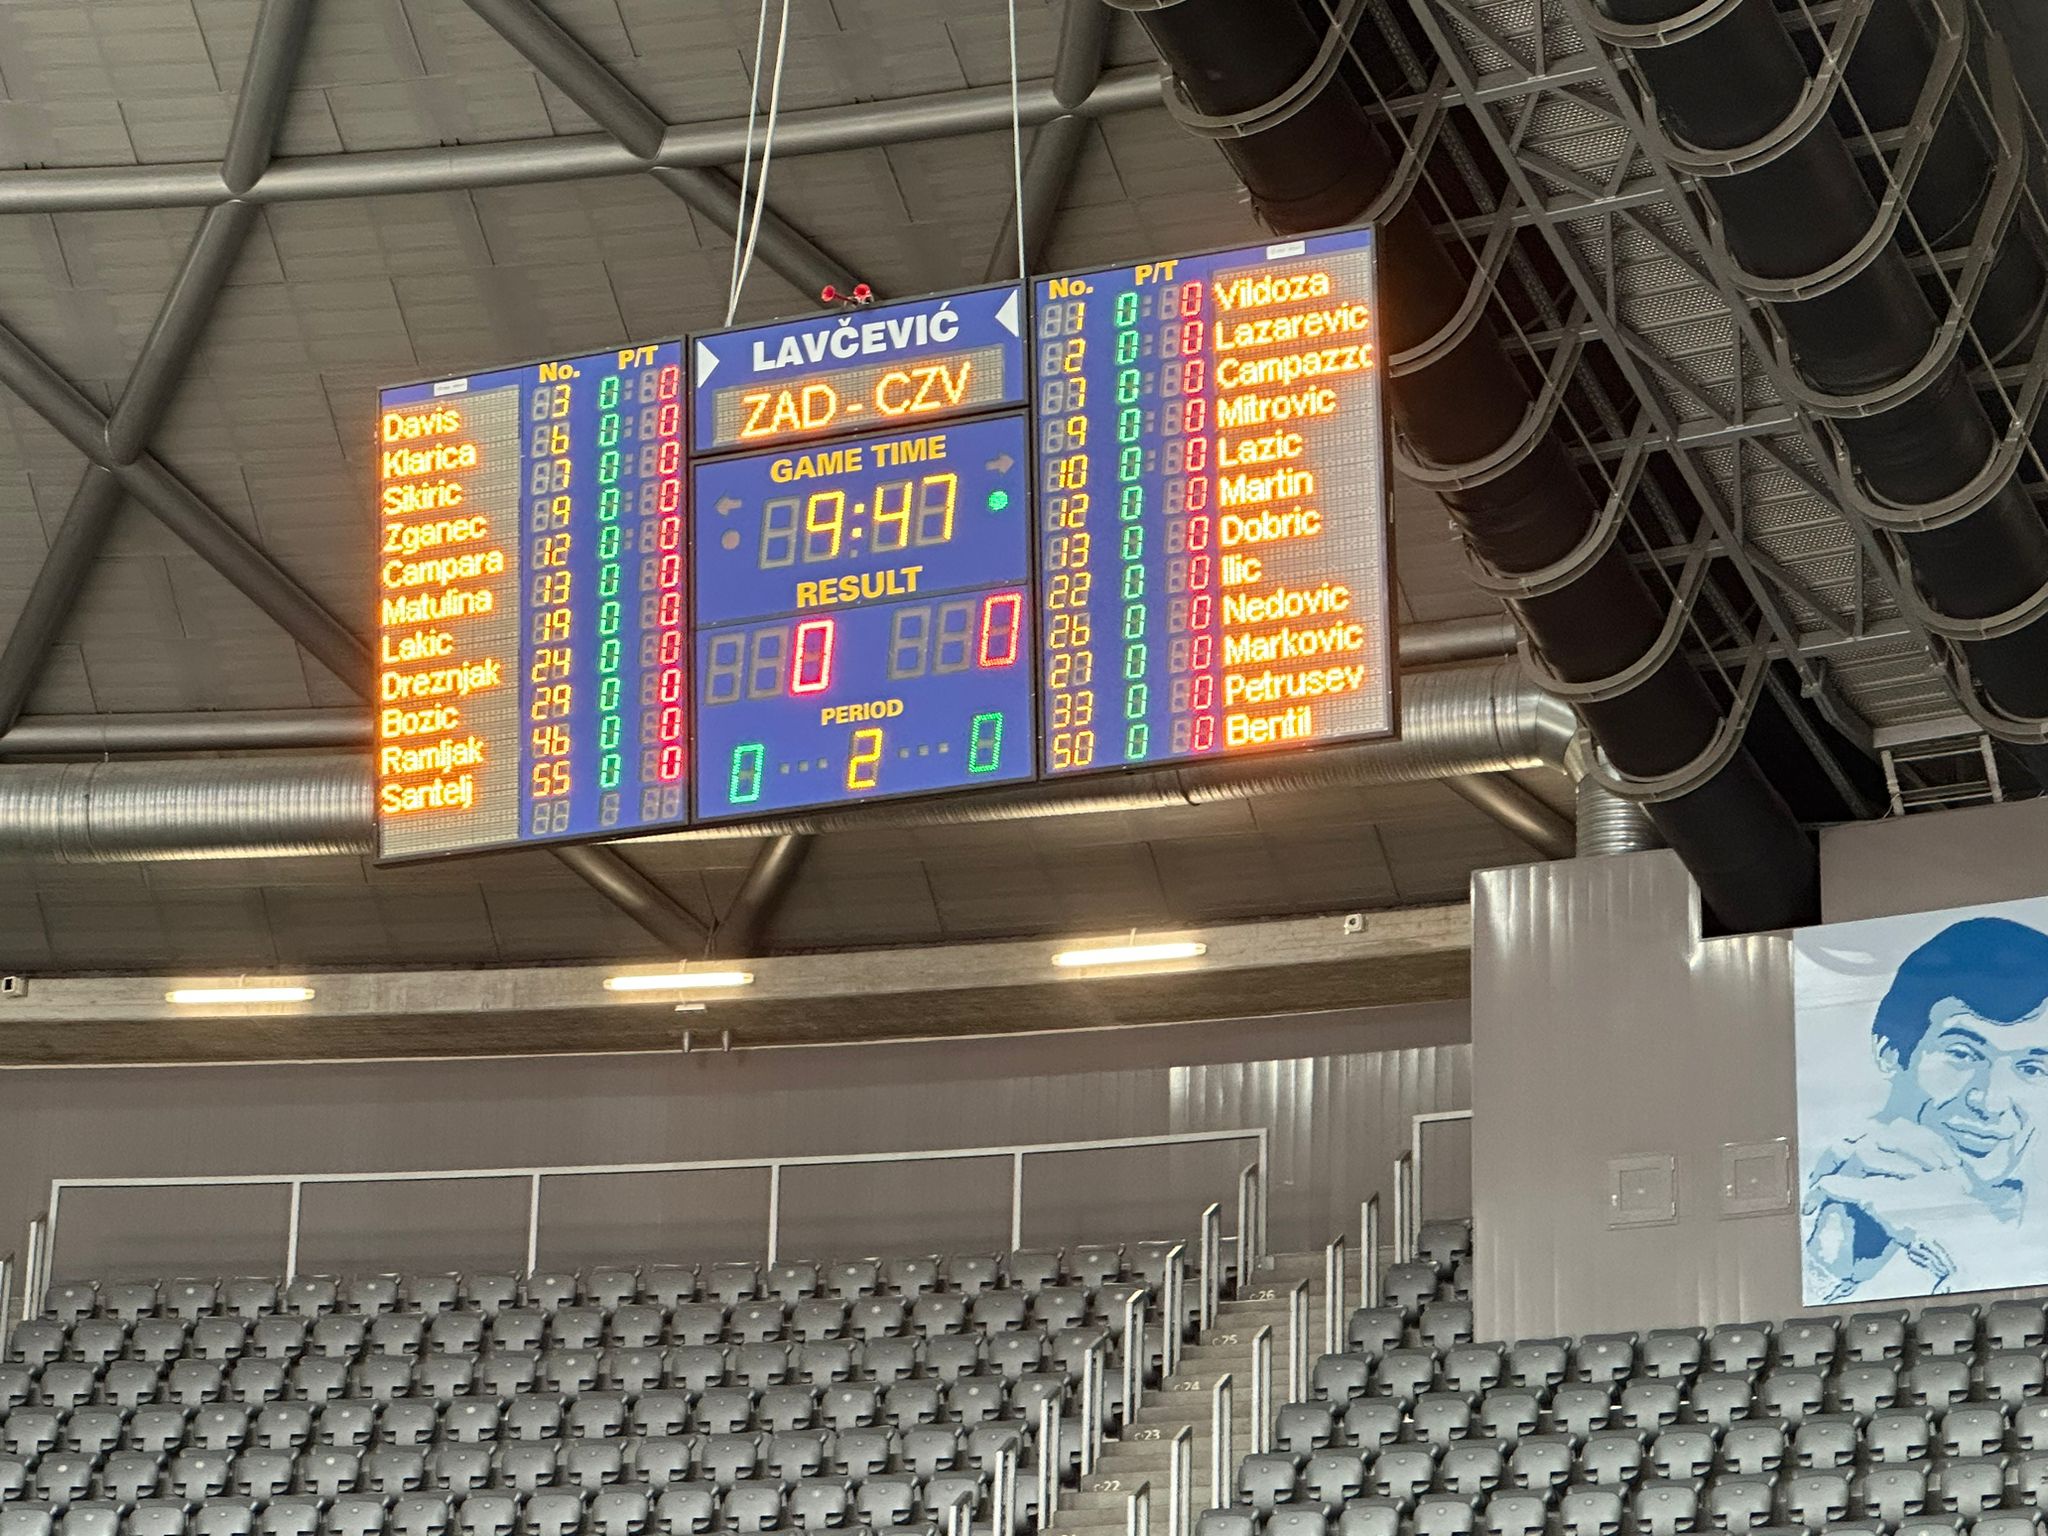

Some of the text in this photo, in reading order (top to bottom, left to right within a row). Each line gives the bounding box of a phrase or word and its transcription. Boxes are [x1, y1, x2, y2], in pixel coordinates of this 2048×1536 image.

[1048, 260, 1178, 299] No. P/T
[1076, 272, 1329, 331] 1 0 0 Vildoza
[539, 345, 658, 382] No. P/T
[753, 301, 959, 372] LAVČEVIĆ
[1066, 301, 1369, 370] 2 0 0 Lazarevic
[383, 365, 680, 442] Davis 3 0 0
[740, 383, 837, 438] ZAD
[876, 360, 971, 415] CZV
[1071, 379, 1087, 409] 7
[1118, 369, 1139, 403] 0
[1183, 359, 1203, 394] 0
[383, 403, 680, 479] Klarica 6 0 0
[1067, 385, 1337, 448] 9 0 0 Mitrovic
[383, 441, 680, 515] Sikiric 7 0 0
[770, 435, 946, 483] GAME TIME
[1059, 428, 1303, 489] 10 0 0 Lazic
[383, 479, 680, 555] Zganec 9 0 0
[806, 472, 957, 556] 9:47
[1060, 467, 1313, 528] 12 0 0 Martin
[383, 517, 680, 589] Campara 12 0 0
[1060, 505, 1321, 568] 13 0 0 Dobric
[544, 572, 571, 607] 13
[600, 565, 620, 598] 0
[660, 556, 680, 589] 0
[796, 566, 923, 608] RESULT
[1049, 553, 1262, 608] 22 0 0 Ilic
[382, 594, 681, 664] Lakic 19 0 0
[978, 593, 1022, 667] 0
[1050, 582, 1350, 648] 26 0 0 Nedovic
[381, 632, 681, 701] Dreznjak 24 0 0
[790, 619, 834, 693] 0
[1051, 621, 1364, 688] 27 0 0 Markovic
[381, 670, 681, 738] Bozic 29 0 0
[821, 699, 904, 726] PERIOD
[1052, 691, 1093, 728] 33
[1127, 684, 1147, 719] 0
[1193, 676, 1213, 710] 0
[532, 723, 571, 760] 46
[600, 716, 621, 750] 0
[661, 708, 681, 741] 0
[848, 728, 882, 789] 2
[968, 712, 1003, 773] 0
[1054, 731, 1094, 768] 50
[1128, 724, 1148, 758] 0
[1195, 716, 1214, 750] 0
[381, 746, 681, 814] Santelj 55 0 0
[729, 744, 765, 803] 0
